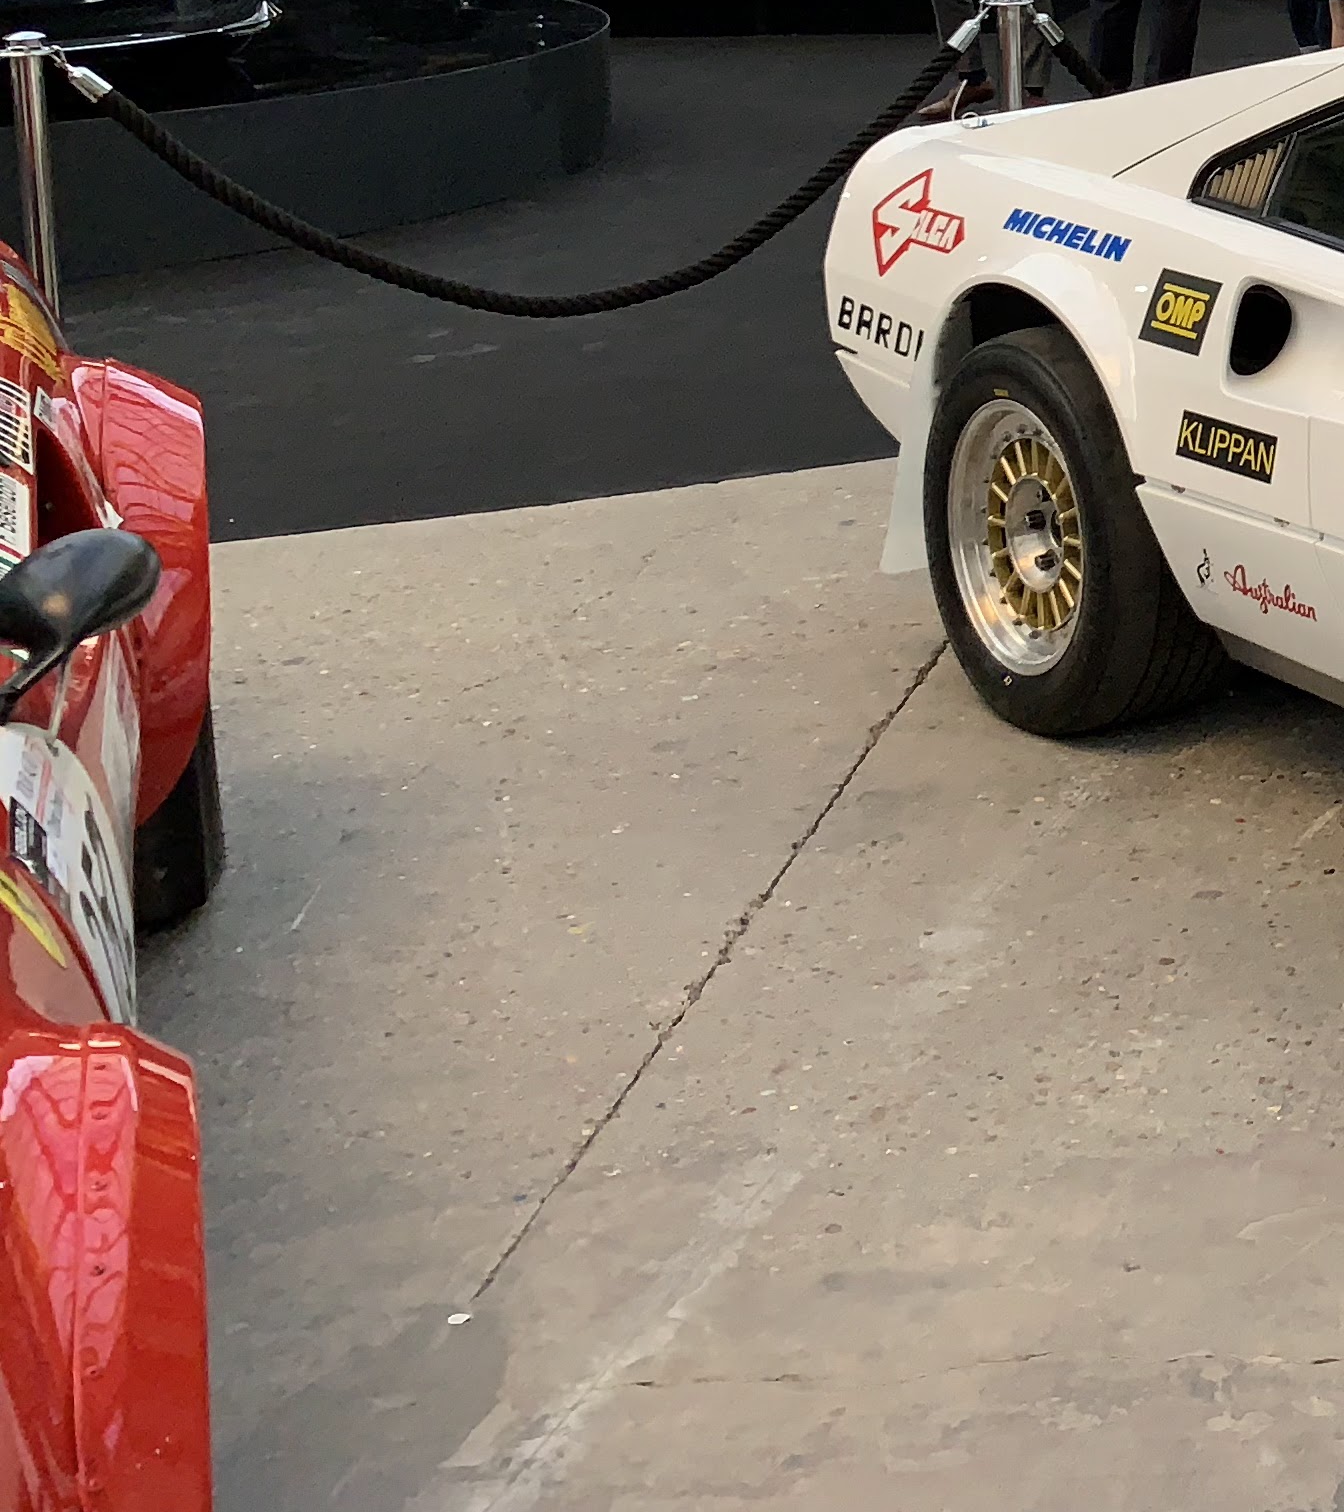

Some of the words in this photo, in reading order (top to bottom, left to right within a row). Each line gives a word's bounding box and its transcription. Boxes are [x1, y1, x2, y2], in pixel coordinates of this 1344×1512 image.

[1003, 207, 1133, 262] MICHELIN
[837, 294, 925, 361] BARDI
[1154, 291, 1207, 330] OMP
[1179, 418, 1276, 476] KLIPPAN
[1225, 562, 1318, 622] Australian
